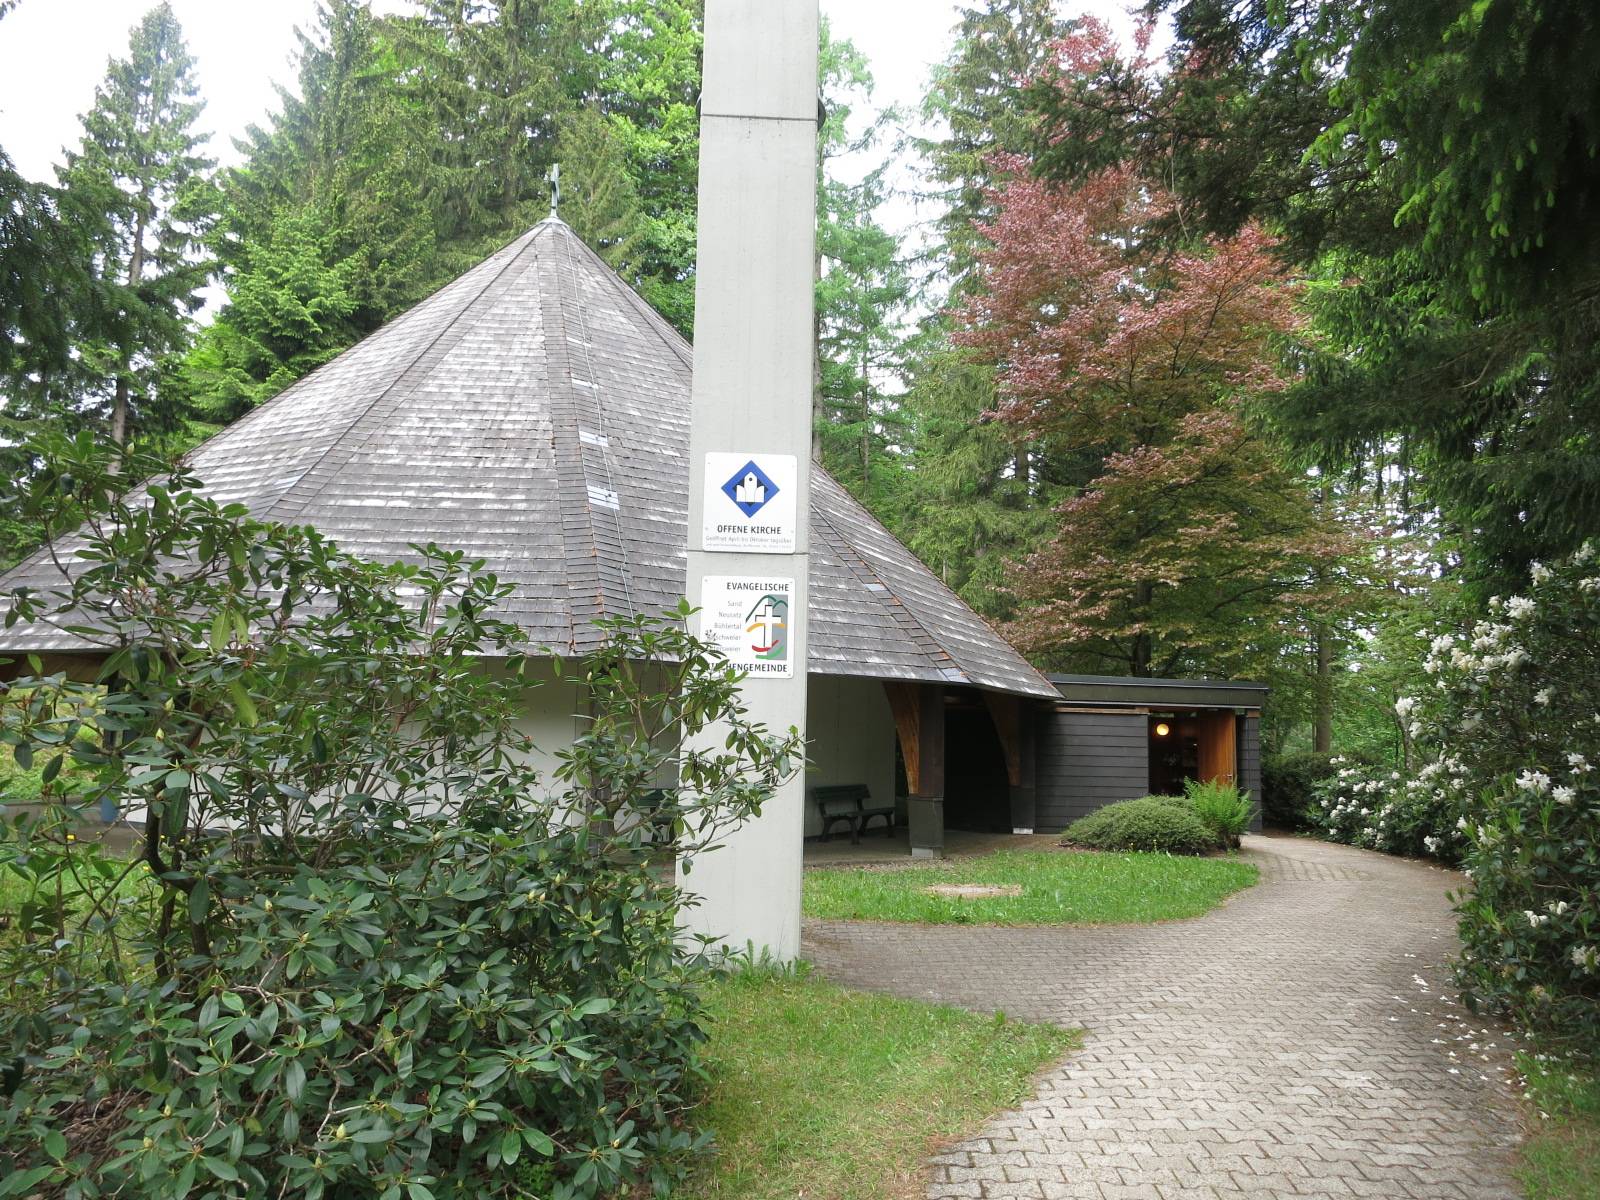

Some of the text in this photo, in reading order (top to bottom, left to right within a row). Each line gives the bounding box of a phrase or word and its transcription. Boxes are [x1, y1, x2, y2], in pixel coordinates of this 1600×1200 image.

[717, 524, 782, 535] OFFENE KIRCHE
[726, 582, 790, 592] EVANGELISCHE
[718, 611, 742, 619] Neusatz
[714, 622, 742, 630] Bühlertal
